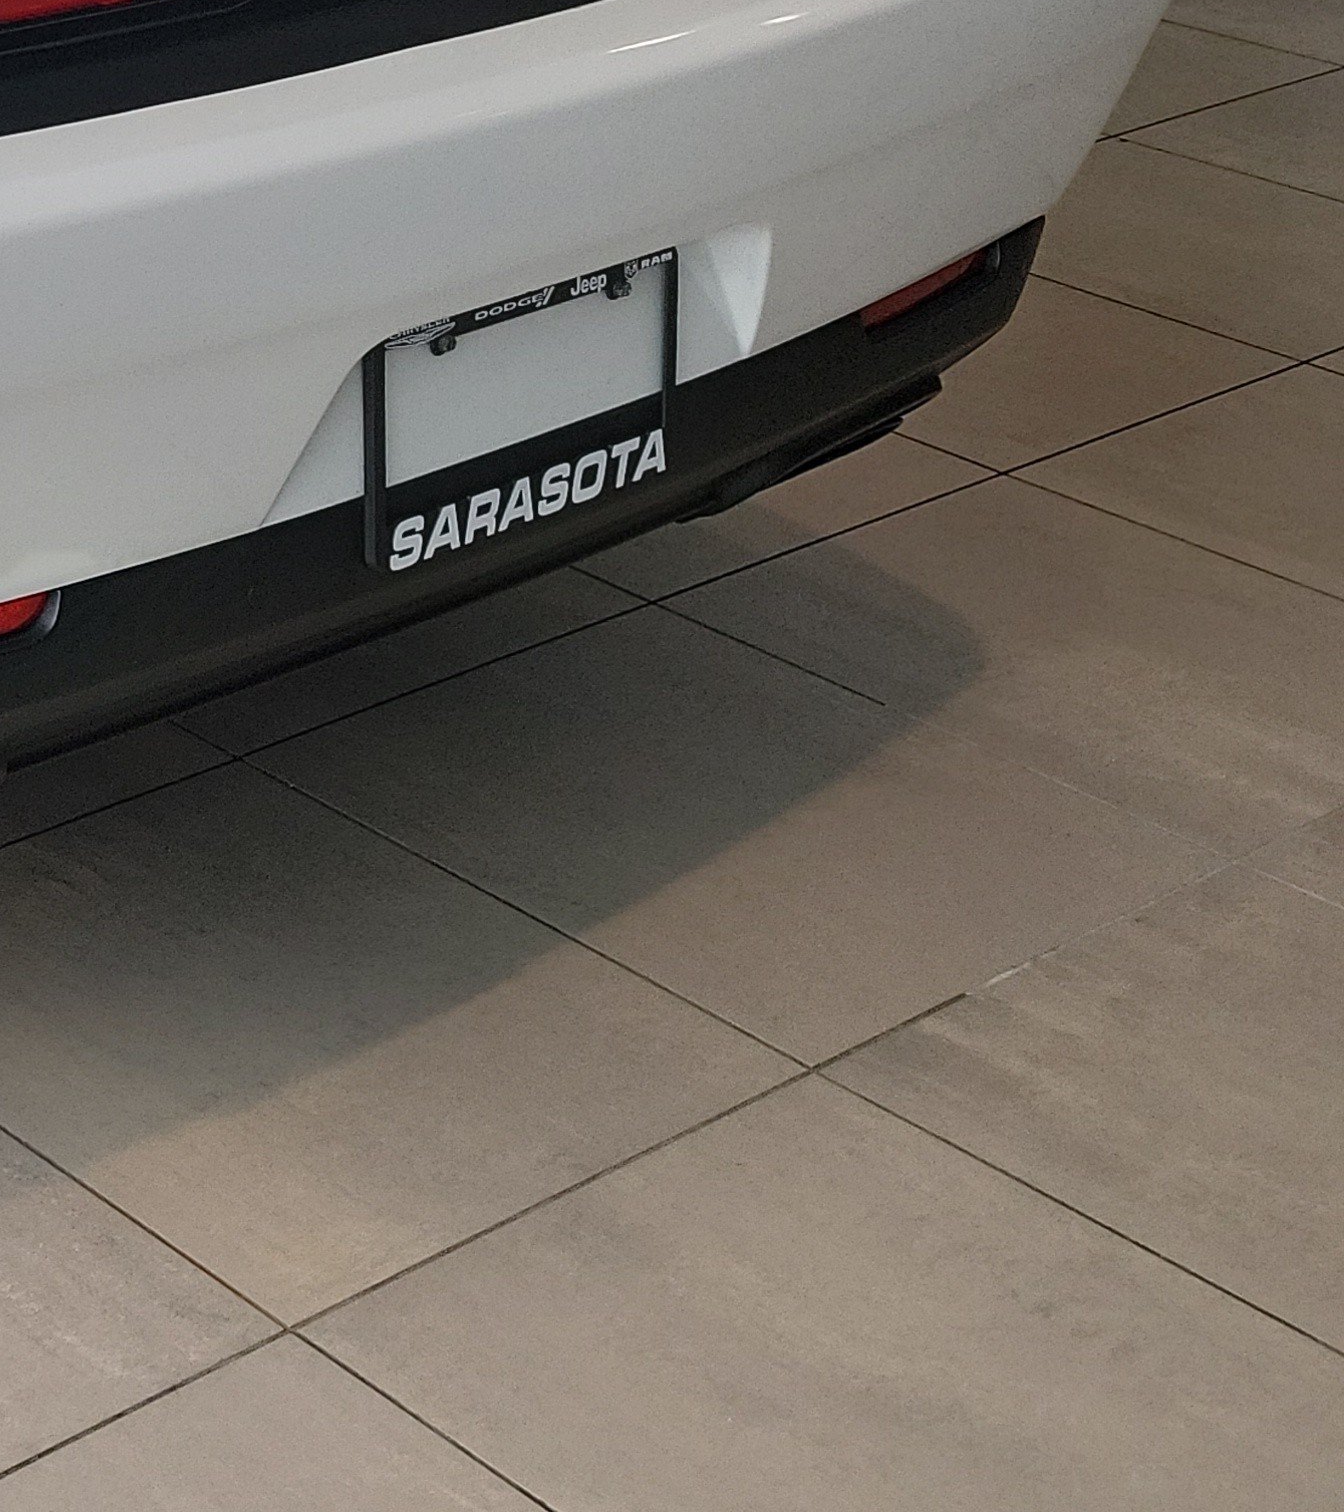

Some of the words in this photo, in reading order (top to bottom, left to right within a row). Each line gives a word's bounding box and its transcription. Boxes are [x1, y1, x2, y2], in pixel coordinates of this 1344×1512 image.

[474, 292, 545, 321] DODGE
[570, 273, 608, 297] Jeep
[641, 251, 674, 270] RAM
[389, 428, 667, 572] SARASOTA
